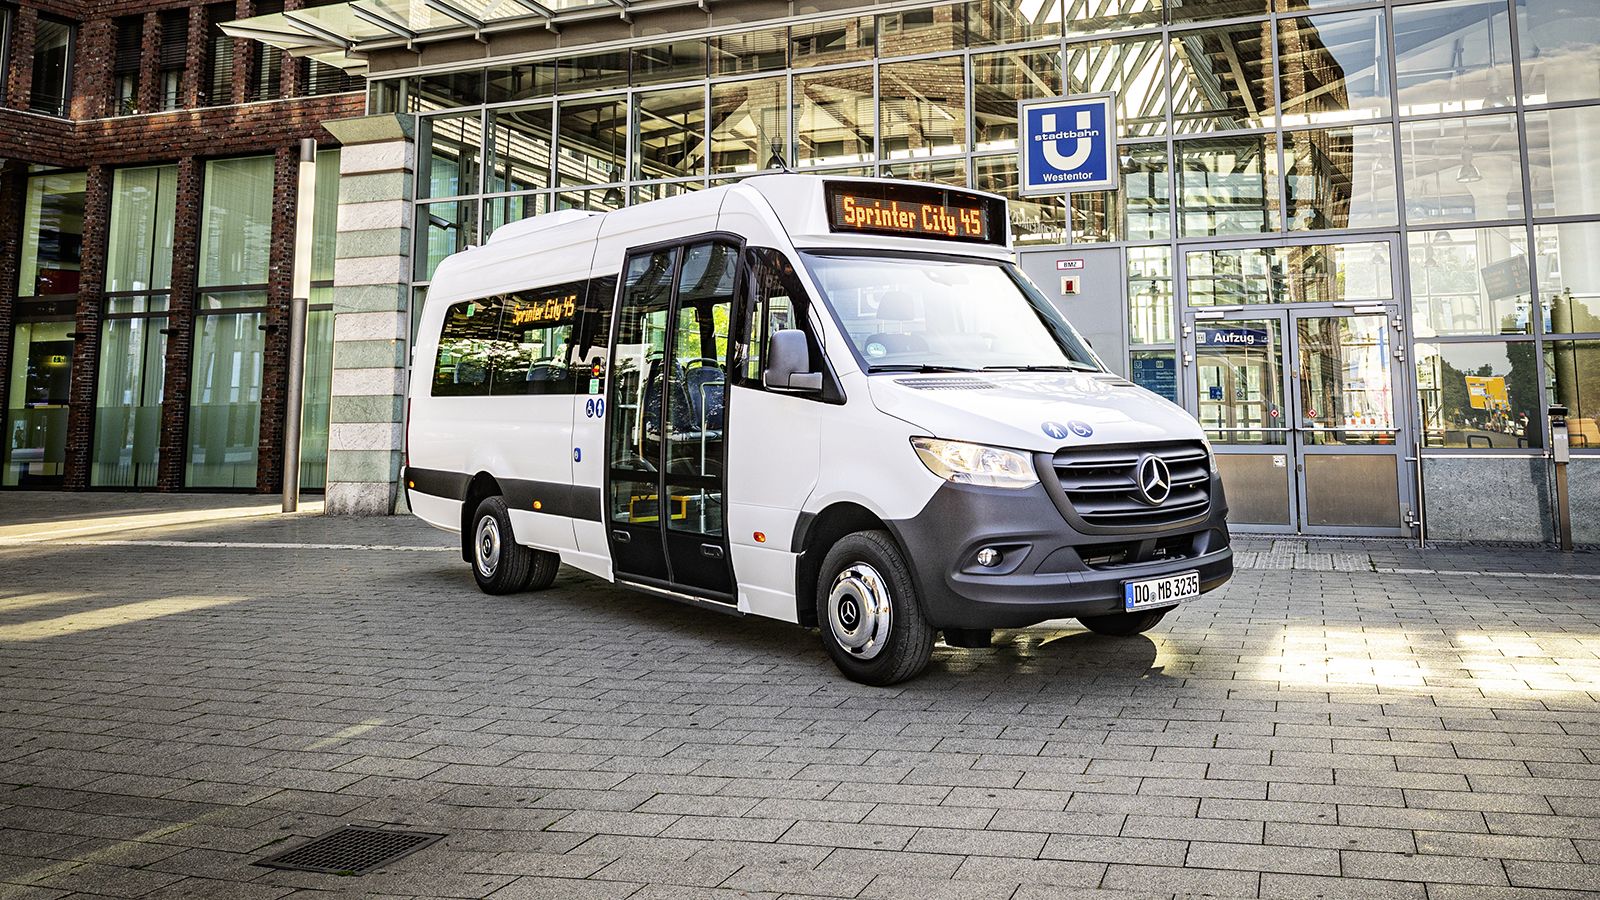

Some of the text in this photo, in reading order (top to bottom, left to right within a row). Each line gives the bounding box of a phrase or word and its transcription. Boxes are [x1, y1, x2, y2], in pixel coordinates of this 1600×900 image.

[1034, 129, 1099, 142] stadtbahn
[1042, 111, 1092, 171] U
[1043, 171, 1093, 182] Westentor
[843, 196, 982, 236] Sprinter City 45
[512, 295, 577, 326] Sprinter City 45
[1214, 332, 1255, 344] Aufzug
[1135, 575, 1198, 603] DO MB 3235
